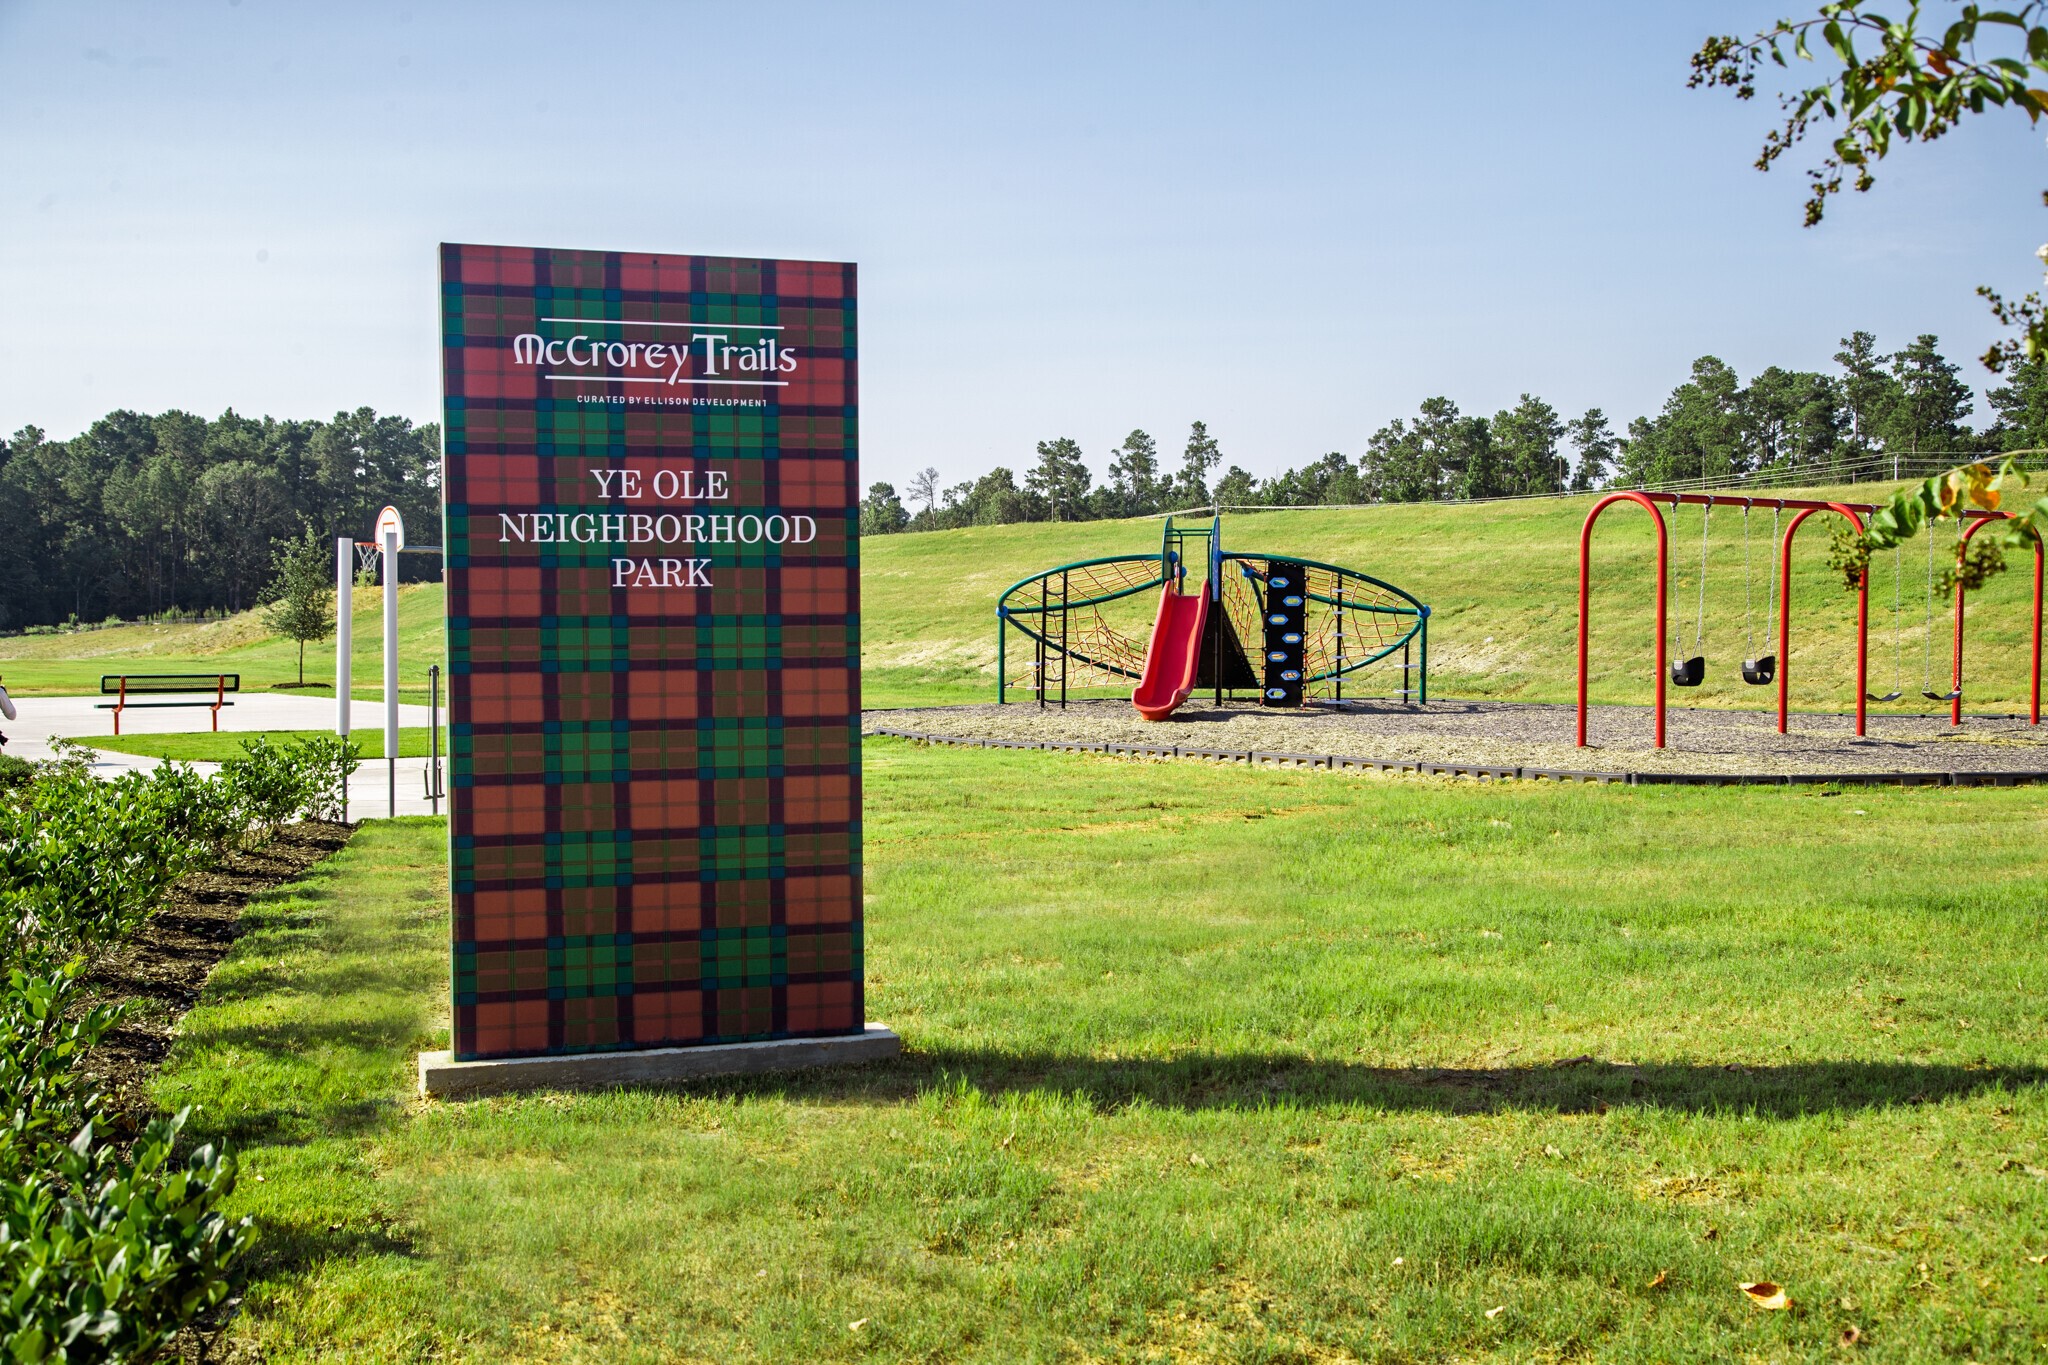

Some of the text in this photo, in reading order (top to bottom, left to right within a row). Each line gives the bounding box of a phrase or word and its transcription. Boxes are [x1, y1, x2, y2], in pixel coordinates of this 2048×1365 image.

[513, 333, 797, 386] McCrorey Trails
[576, 394, 767, 407] CURATED BY ELLISON DEVELOPMENT
[589, 469, 728, 499] YE OLE
[498, 513, 817, 543] NEIGHBORHOOD
[612, 558, 713, 587] PARK
